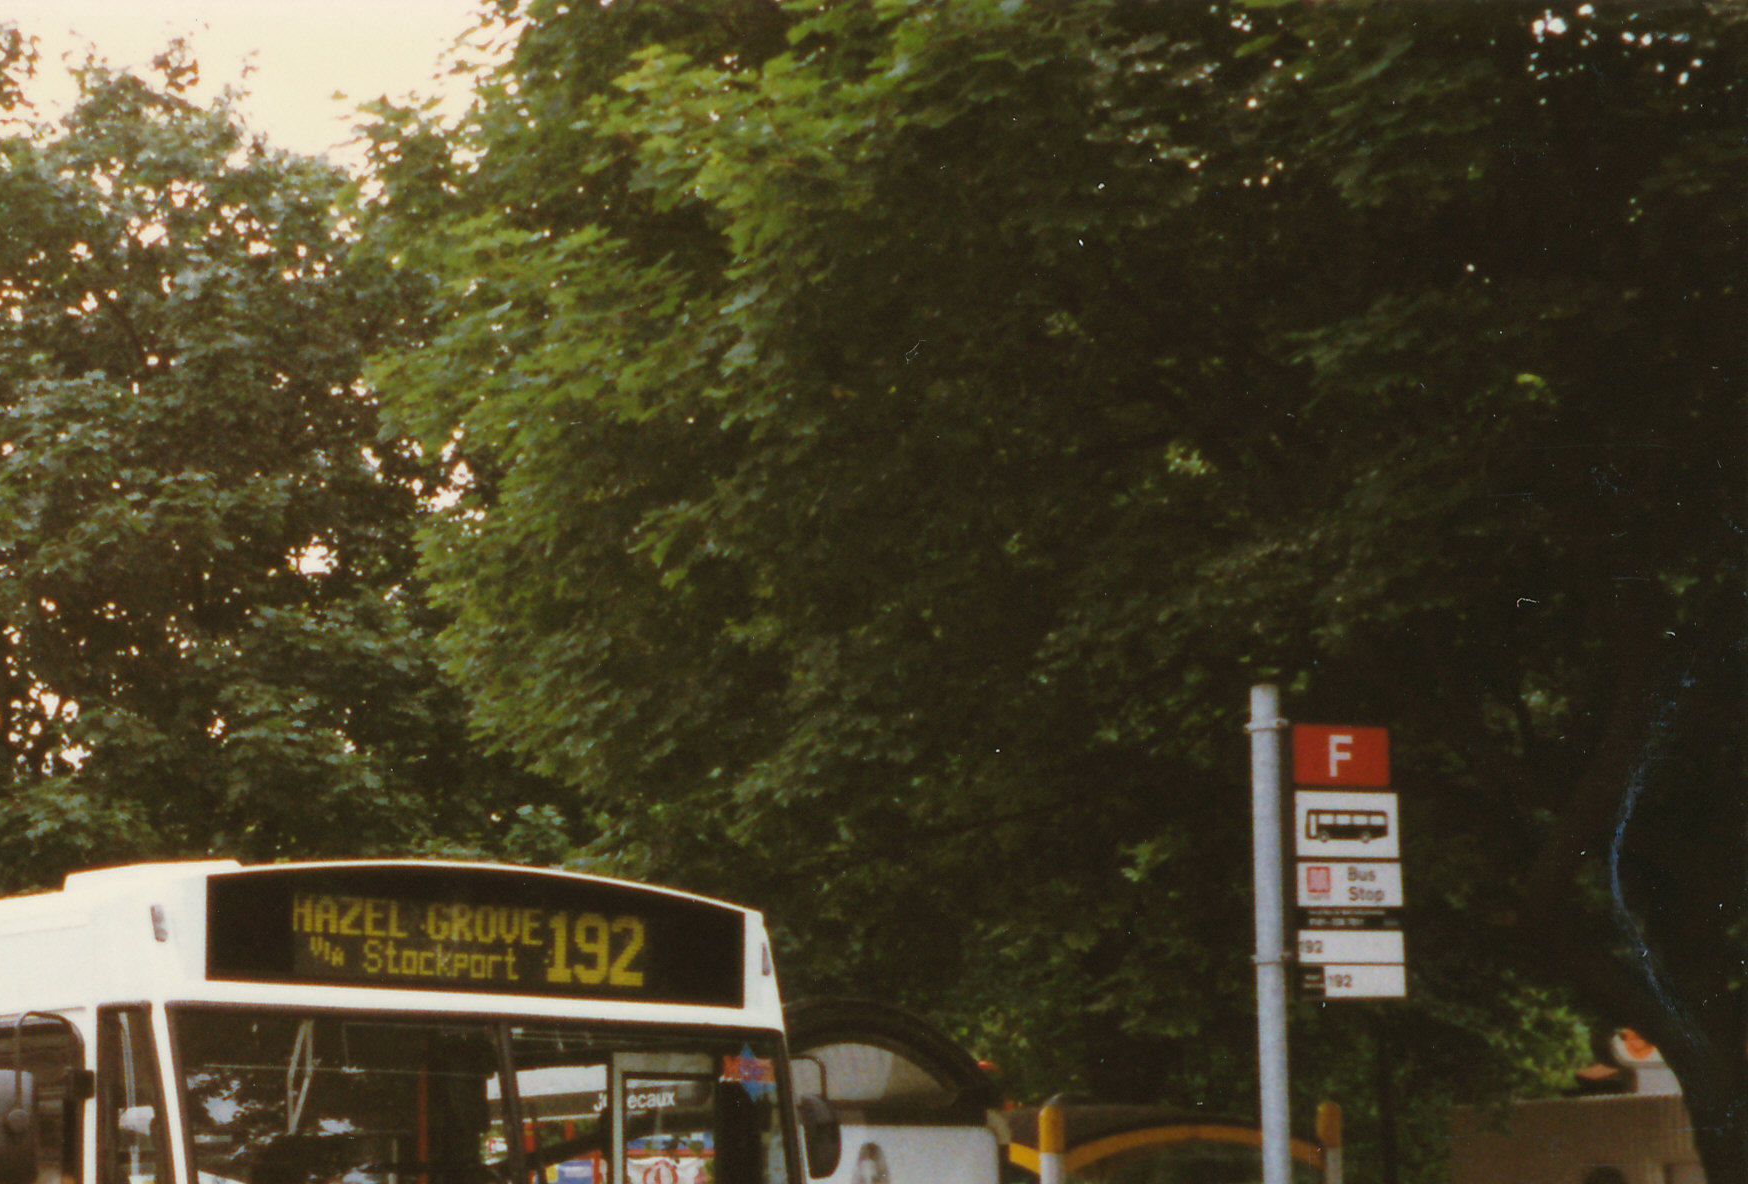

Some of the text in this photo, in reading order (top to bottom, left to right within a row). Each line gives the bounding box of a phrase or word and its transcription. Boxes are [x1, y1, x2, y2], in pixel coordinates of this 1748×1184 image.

[1329, 735, 1353, 777] F
[1347, 866, 1376, 882] Bus
[1348, 886, 1385, 903] Stop
[293, 894, 543, 946] HAZEL GROVE
[363, 940, 519, 981] Stockport
[547, 911, 645, 987] 192
[593, 1091, 676, 1112] Jecaux
